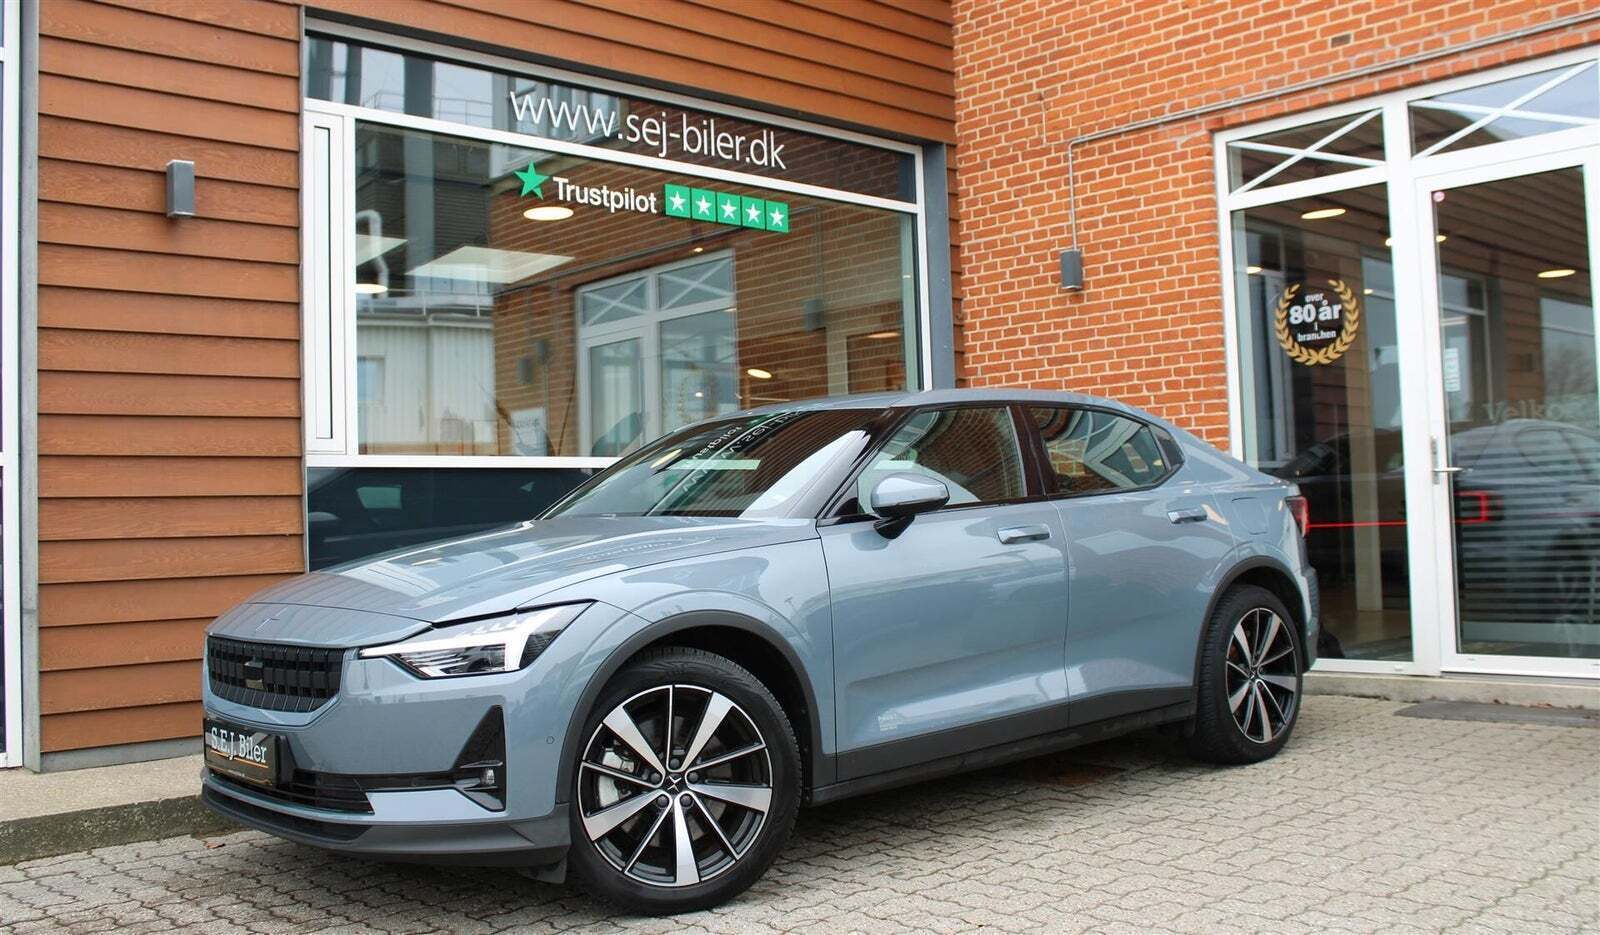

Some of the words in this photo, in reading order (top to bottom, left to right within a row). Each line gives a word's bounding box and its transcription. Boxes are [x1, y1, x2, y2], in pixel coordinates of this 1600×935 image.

[510, 91, 787, 170] www.sej-biler.dk
[553, 176, 657, 215] Trustpilot
[1289, 303, 1316, 325] 80
[1318, 299, 1343, 322] år
[1304, 292, 1325, 303] over
[1296, 329, 1337, 342] branchen
[211, 726, 237, 761] S.E.J.
[239, 734, 267, 764] Biler
